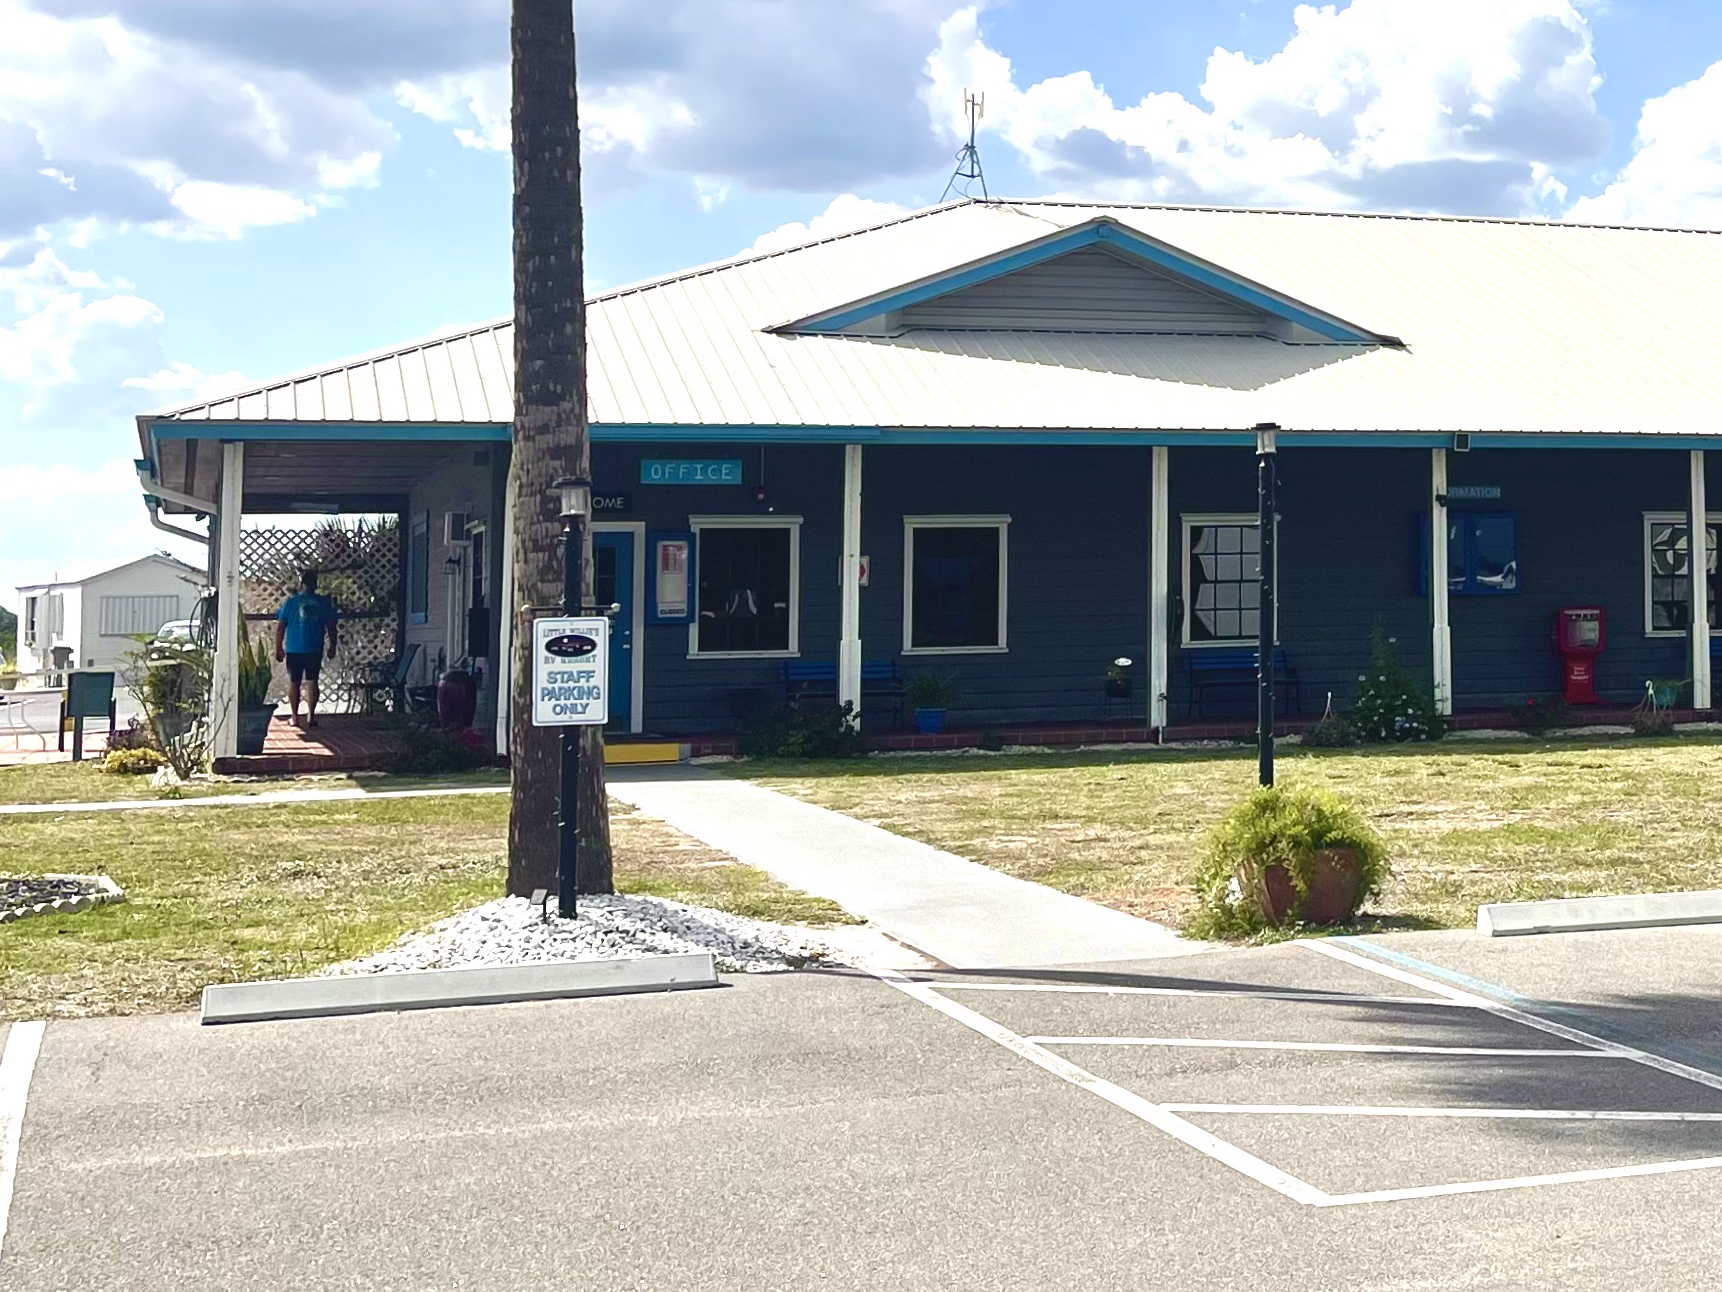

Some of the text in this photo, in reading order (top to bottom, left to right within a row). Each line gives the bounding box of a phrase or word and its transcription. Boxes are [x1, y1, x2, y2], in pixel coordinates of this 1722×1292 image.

[651, 464, 733, 480] OFFICE
[547, 670, 596, 684] STAFF
[541, 685, 601, 702] PARKING
[552, 703, 590, 715] ONLY
